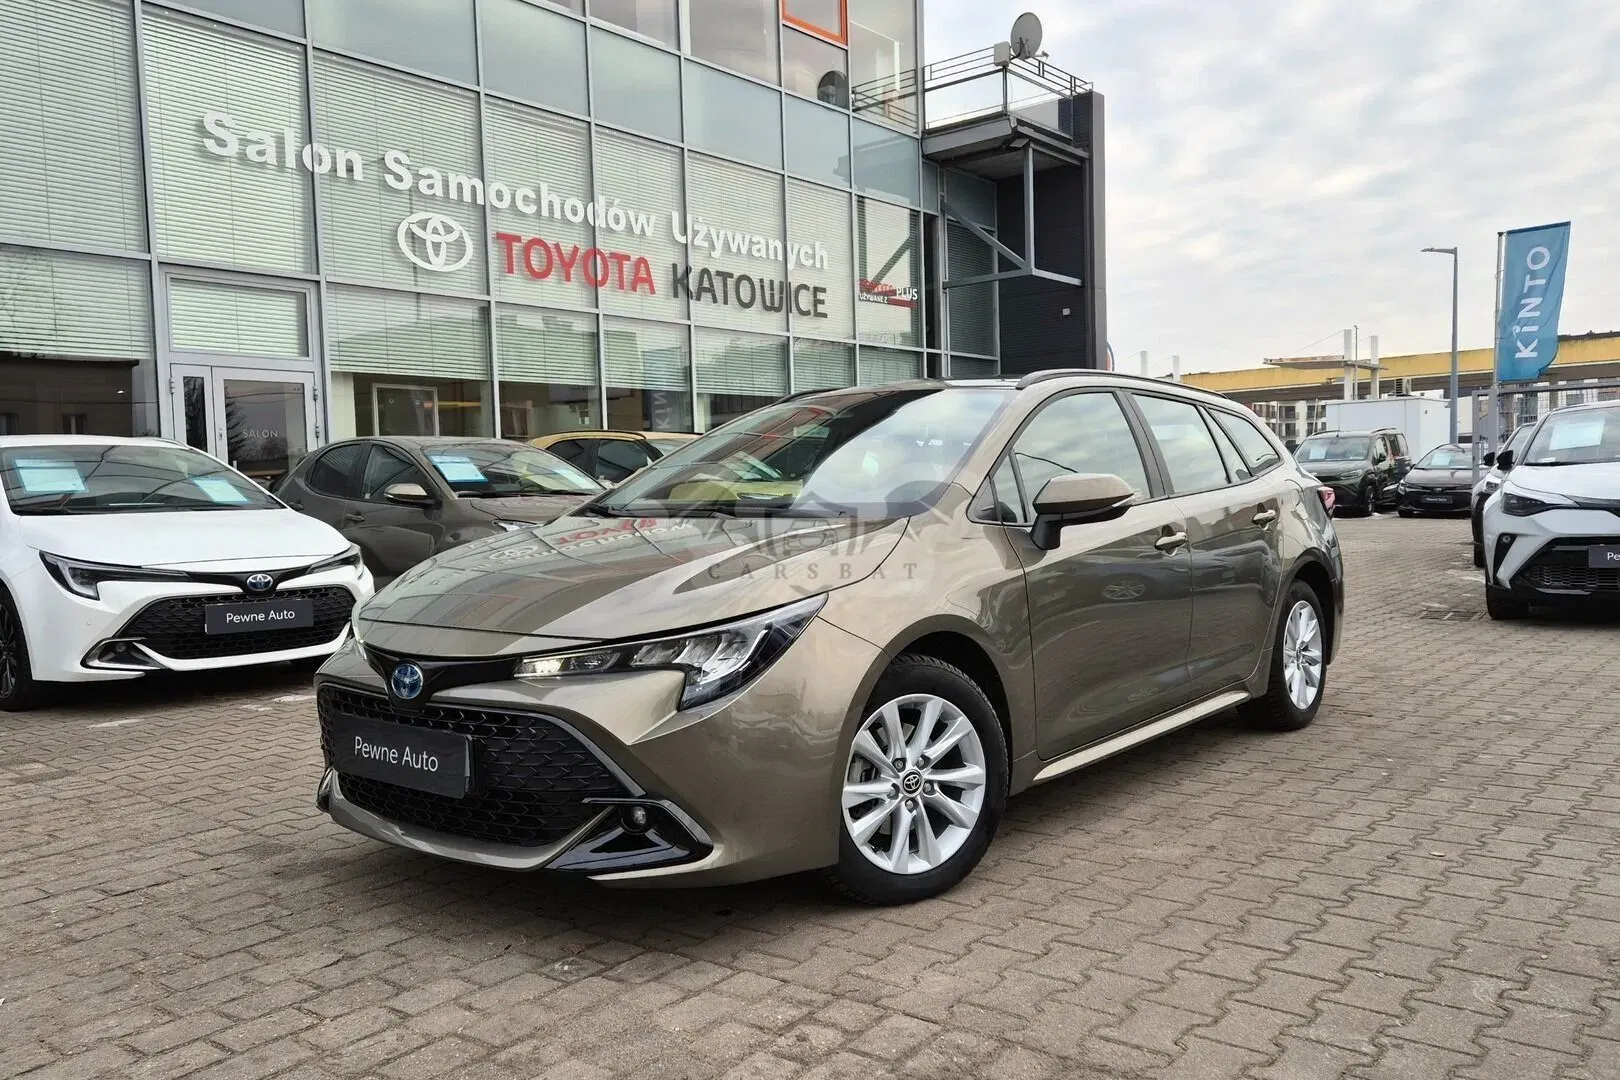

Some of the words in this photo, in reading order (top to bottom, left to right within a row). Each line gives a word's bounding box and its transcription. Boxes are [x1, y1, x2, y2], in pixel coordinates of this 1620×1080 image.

[202, 111, 363, 181] Salon
[384, 149, 656, 237] Samochodów
[671, 211, 828, 270] Używanych
[496, 232, 657, 296] TOYOTA
[672, 263, 828, 319] KATOWICE
[896, 287, 918, 300] PLUS
[243, 429, 278, 438] SALON
[226, 613, 265, 624] Pewne
[268, 610, 296, 620] Auto
[354, 736, 398, 764] Pewne
[402, 746, 439, 772] Auto
